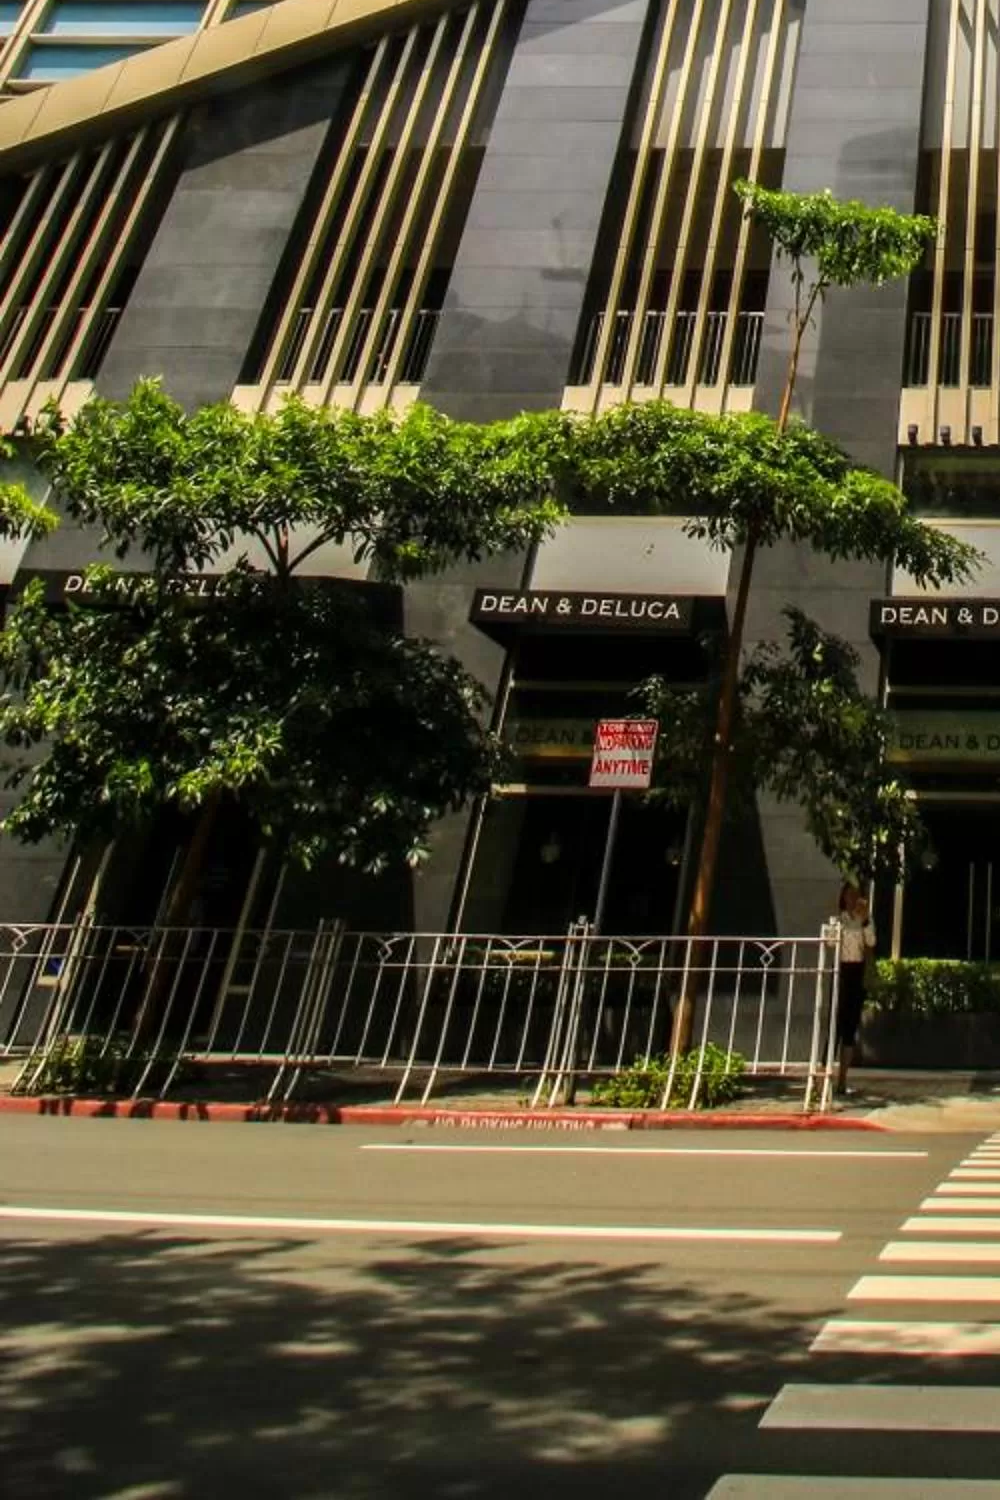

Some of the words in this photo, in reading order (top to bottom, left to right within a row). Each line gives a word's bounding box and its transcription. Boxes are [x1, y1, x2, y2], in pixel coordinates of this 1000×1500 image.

[480, 595, 548, 613] DEAN
[556, 598, 572, 615] &
[581, 599, 680, 619] DELUCA
[880, 607, 947, 625] DEAN
[957, 607, 973, 625] &
[598, 733, 613, 751] NO
[900, 733, 960, 750] DEAN
[966, 734, 979, 750] &
[594, 759, 649, 774] ANYTIME
